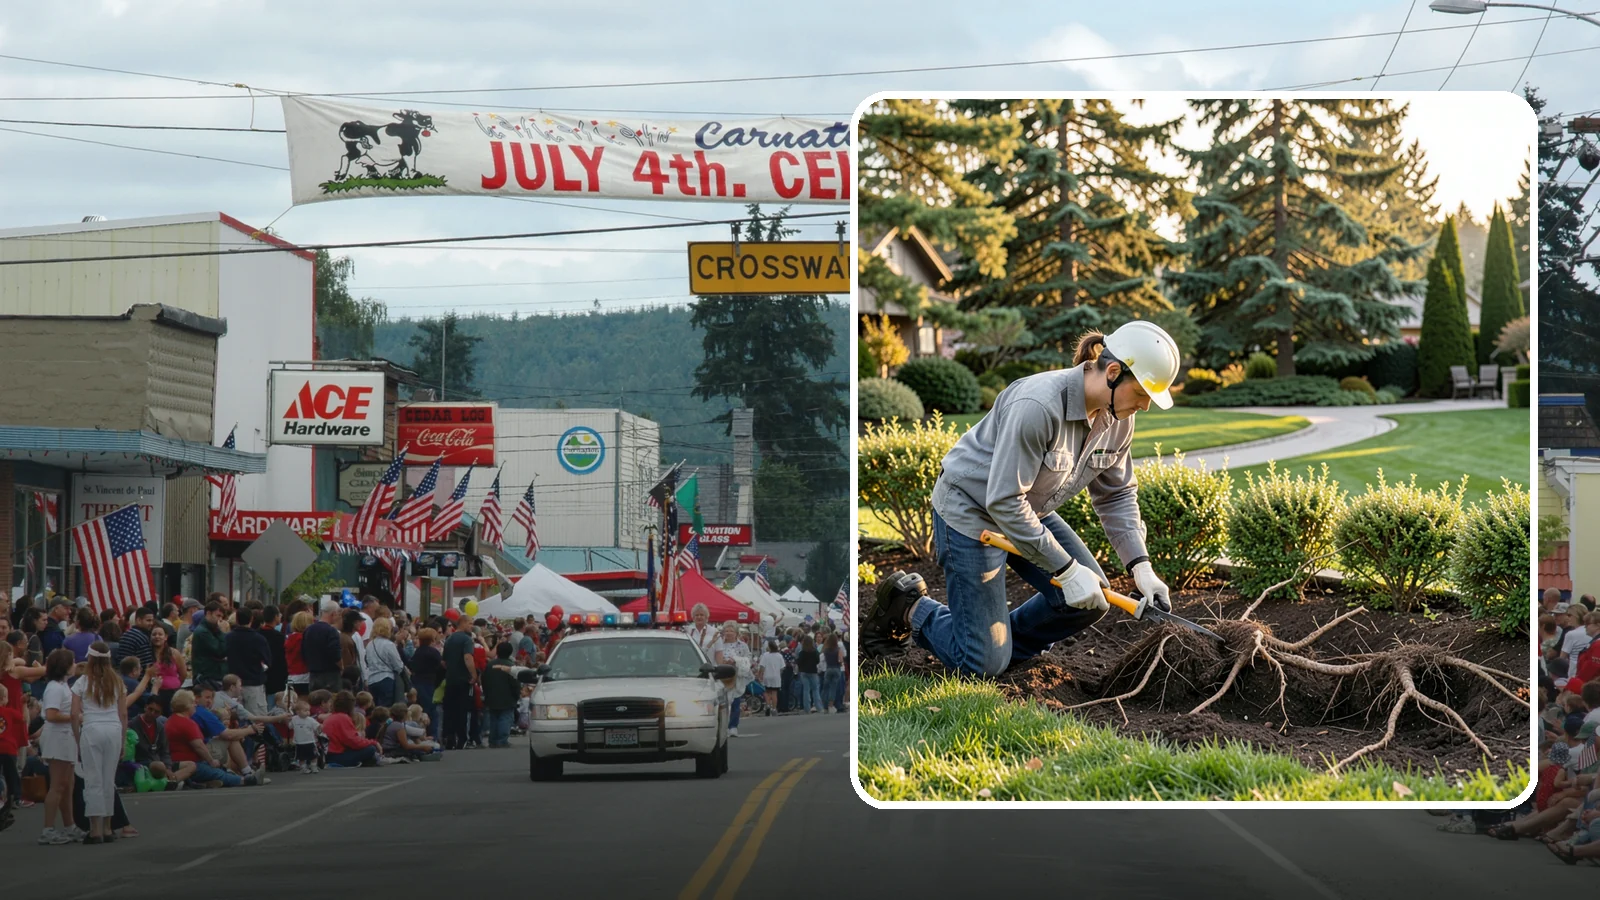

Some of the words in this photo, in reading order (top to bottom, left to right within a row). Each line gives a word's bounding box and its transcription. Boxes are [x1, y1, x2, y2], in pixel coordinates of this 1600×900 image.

[695, 121, 850, 150] Carnat
[481, 141, 604, 192] JULY
[632, 149, 746, 197] 4th.
[696, 254, 850, 280] CROSSWA
[282, 380, 373, 419] ACE
[405, 409, 452, 422] CEDAR
[283, 421, 370, 436] Hardware
[353, 467, 386, 478] Simpl
[96, 486, 125, 495] Vincent
[138, 487, 156, 495] Paul
[81, 503, 154, 521] THT
[212, 516, 331, 535] HARDARE
[688, 527, 741, 535] CRNATION
